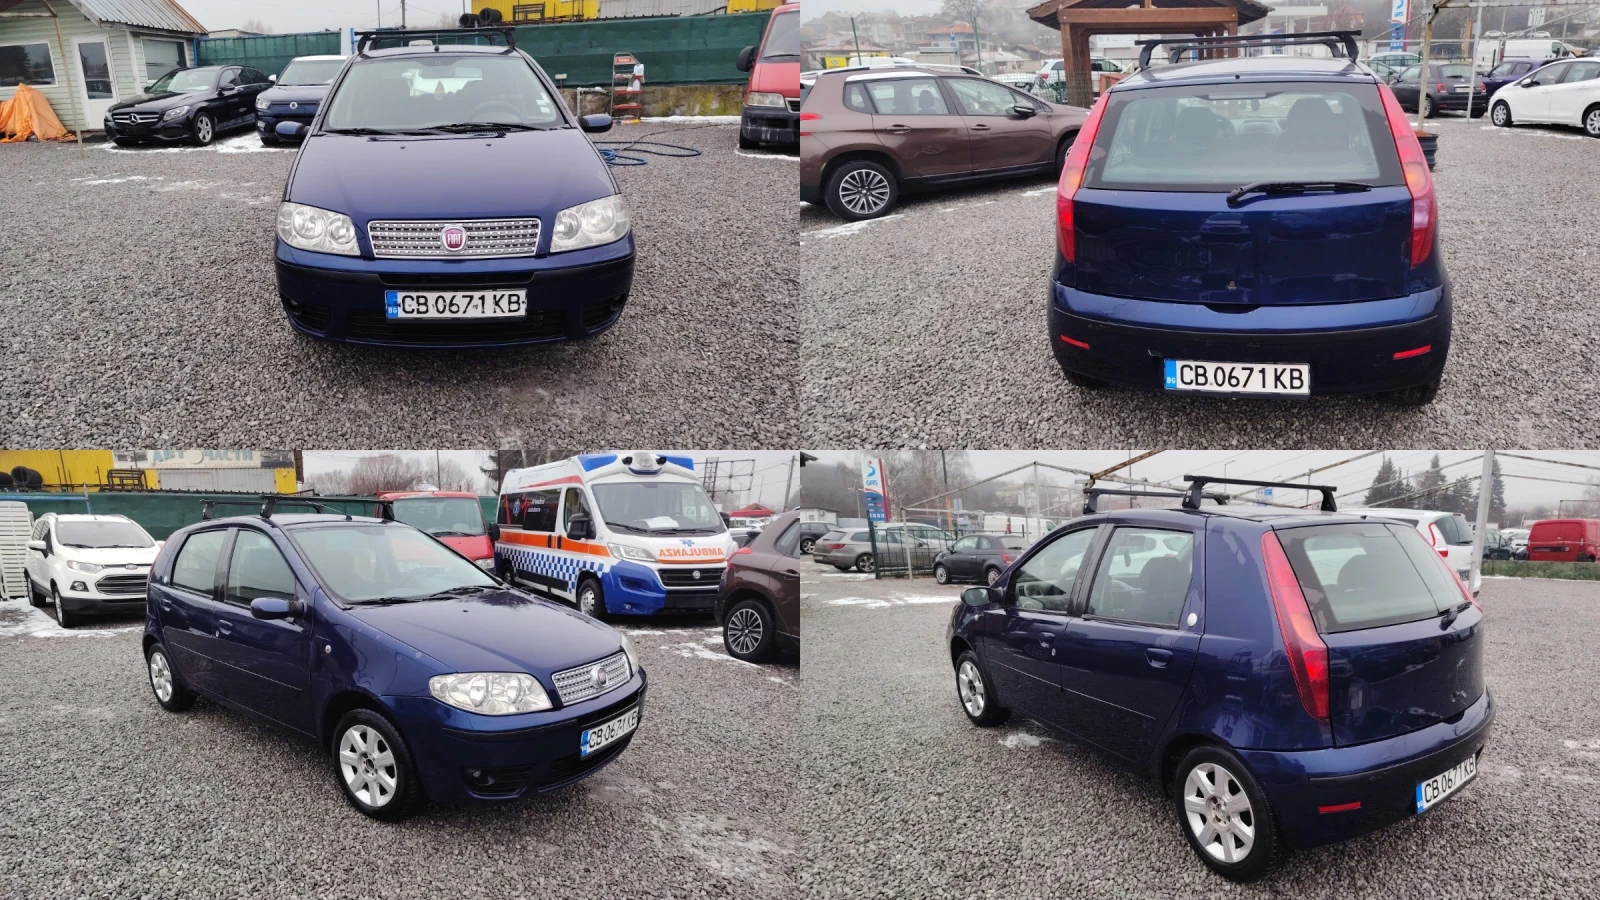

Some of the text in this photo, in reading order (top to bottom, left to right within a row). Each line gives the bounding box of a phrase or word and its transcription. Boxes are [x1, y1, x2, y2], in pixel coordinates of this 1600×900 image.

[447, 233, 462, 245] FIAT
[388, 306, 398, 314] BG
[401, 294, 521, 314] CB 0671 KB
[1180, 364, 1304, 390] CB 0671 KB
[588, 728, 603, 749] CB
[604, 717, 626, 741] 0671
[1424, 757, 1474, 804] CB 0671 KB
